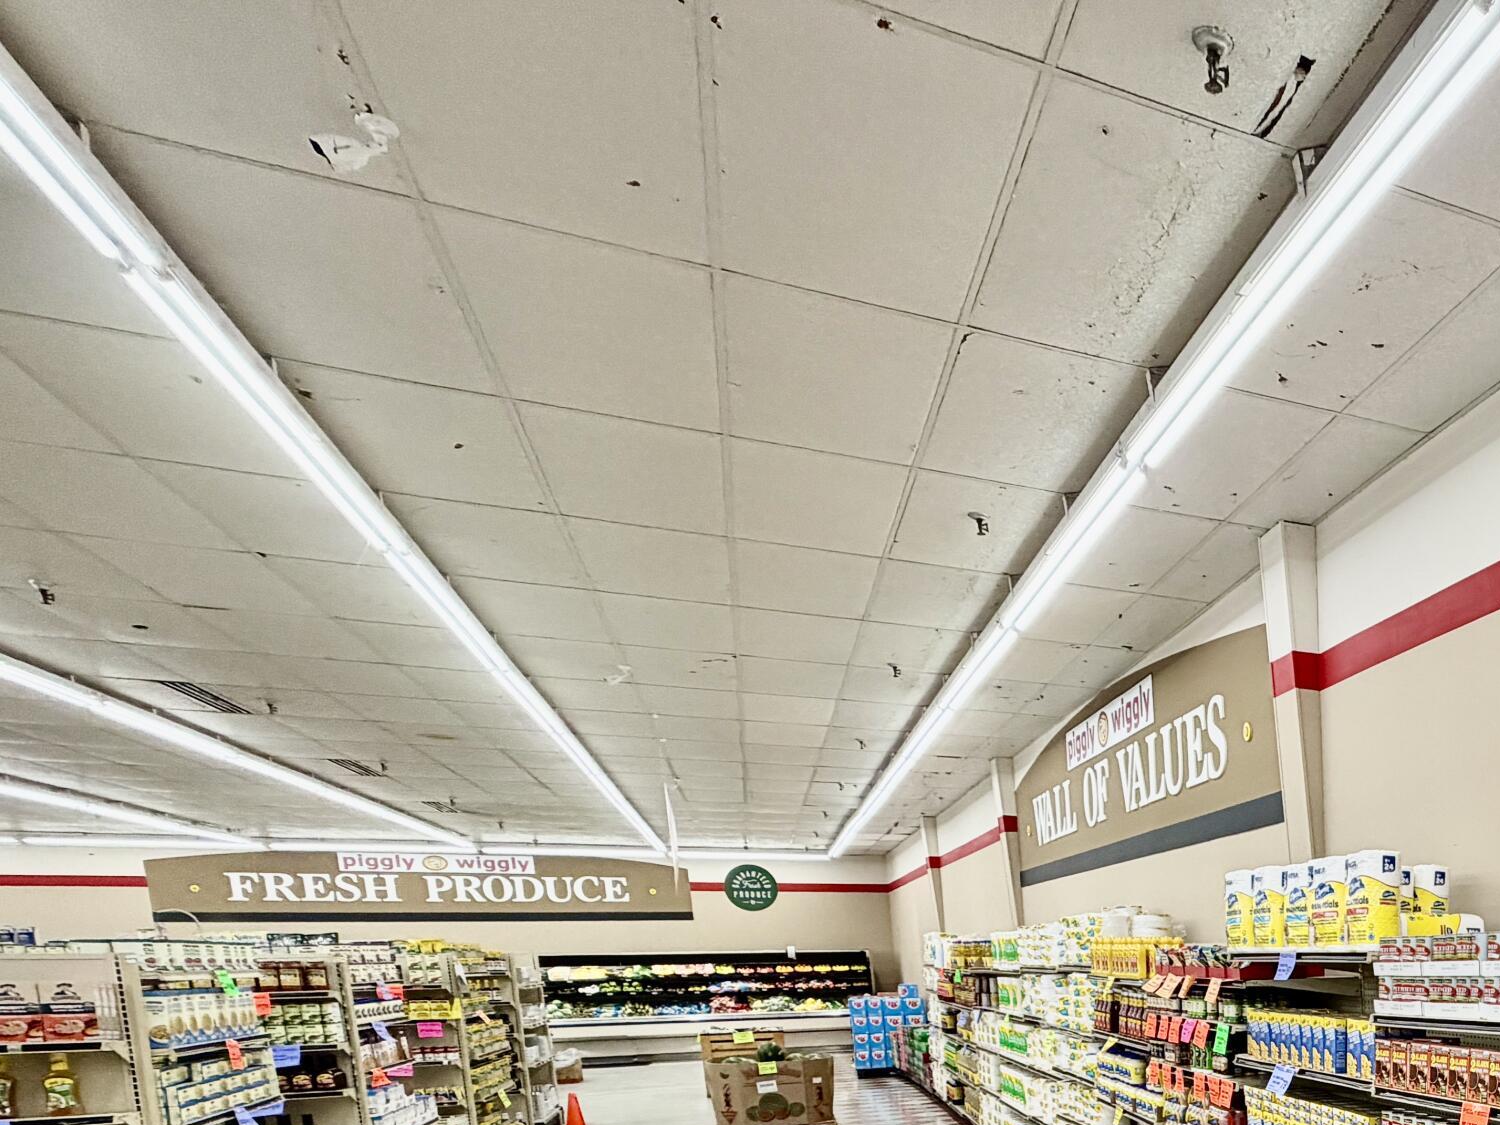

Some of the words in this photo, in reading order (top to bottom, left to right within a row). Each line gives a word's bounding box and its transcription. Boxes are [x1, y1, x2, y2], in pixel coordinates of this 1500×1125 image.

[1067, 722, 1095, 760] piggly
[1111, 685, 1150, 733] wiggly
[1032, 780, 1078, 847] WALL
[1083, 758, 1110, 827] OF
[1116, 694, 1228, 813] VALUES
[223, 872, 403, 901] FRESH
[421, 875, 630, 902] PRODUCE
[342, 854, 415, 871] piggly
[456, 857, 529, 873] wiggly
